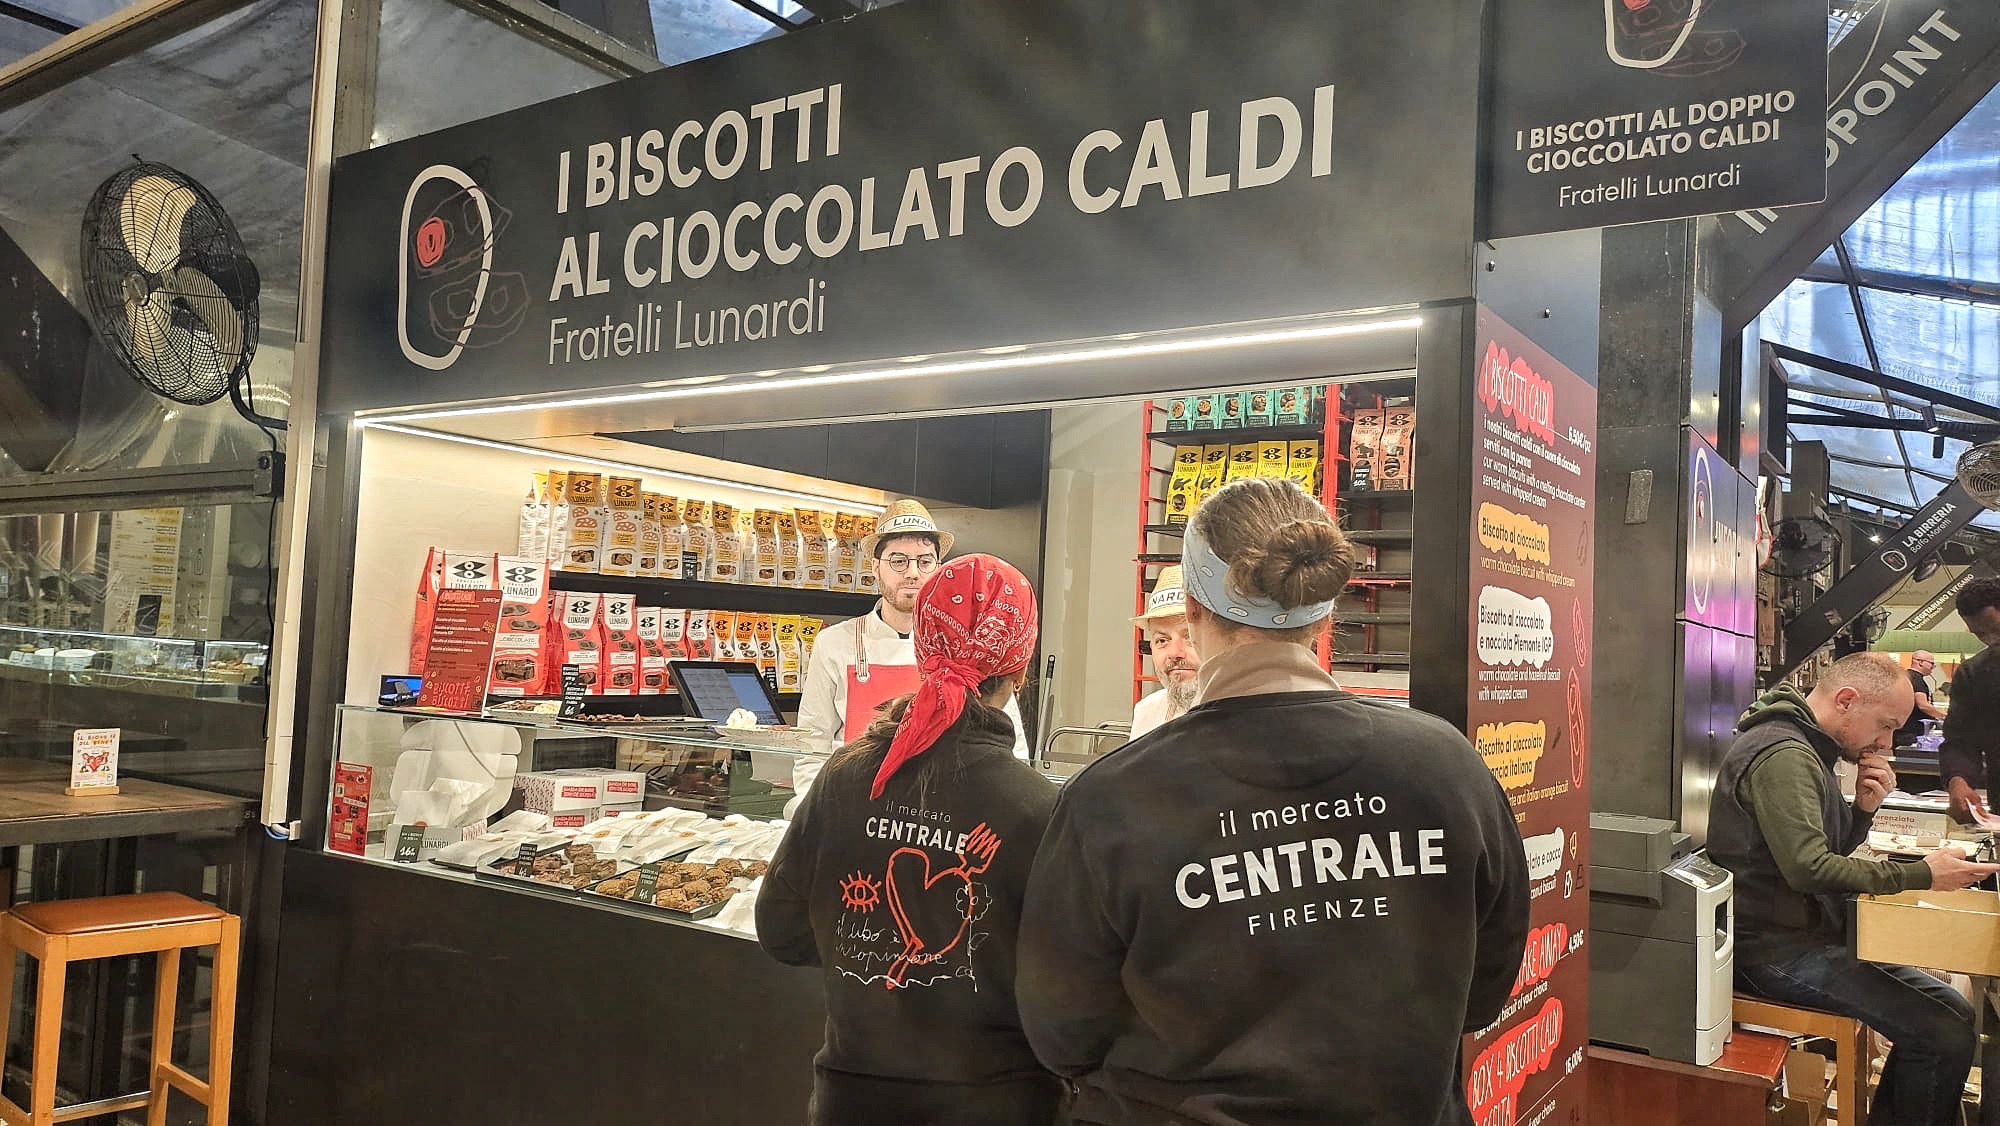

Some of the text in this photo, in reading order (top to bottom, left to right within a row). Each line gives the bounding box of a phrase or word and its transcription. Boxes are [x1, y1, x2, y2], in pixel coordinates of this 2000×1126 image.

[1516, 90, 1795, 151] I BISCOTTI AL DOPPIO
[557, 84, 842, 214] I BISCOTTI
[1527, 118, 1780, 174] CIOCCOLATO CALDI
[549, 84, 1335, 301] AL CIOCCOLATO CALDI
[1559, 163, 1741, 207] Fratelli Lunardi
[549, 278, 826, 365] Fratelli Lunardi
[1491, 358, 1527, 416] BISCOTTI
[1529, 383, 1550, 429] CALDI
[1487, 420, 1502, 437] nostri
[1502, 424, 1521, 445] biscotti
[1493, 458, 1508, 475] warm
[1516, 453, 1531, 469] panna
[1482, 474, 1546, 508] served with whipped cream
[1482, 517, 1546, 553] Biscotto al cioccolato
[1901, 502, 1957, 548] LA BIRRERIA
[1480, 556, 1496, 570] warm
[1498, 557, 1520, 576] chocolate
[1480, 605, 1544, 630] Biscotto al cioccolato
[1913, 593, 1950, 625] VEGETARIANO
[1951, 573, 1975, 595] VEGANO
[1480, 636, 1484, 649] e
[1485, 631, 1513, 651] nocciola
[1514, 633, 1541, 653] Piemonte
[1478, 670, 1495, 681] warm
[1494, 666, 1519, 681] chocolate
[1478, 685, 1490, 701] with
[1490, 684, 1512, 705] whipped
[1505, 734, 1512, 753] al
[1512, 732, 1543, 752] cioccolato
[1509, 757, 1533, 777] italiana
[898, 804, 952, 824] mercato
[1219, 792, 1387, 837] il mercato
[865, 816, 969, 855] CENTRALE
[1175, 829, 1447, 909] CENTRALE
[1541, 853, 1546, 865] e
[1546, 847, 1561, 863] cocco
[1248, 896, 1390, 936] FIRENZE
[1539, 923, 1562, 975] AWAY
[1501, 998, 1518, 1022] biscuit
[1522, 988, 1533, 1011] your
[1533, 979, 1548, 999] choice
[1472, 1004, 1560, 1111] BOX 4 BISCOTTI CALDI
